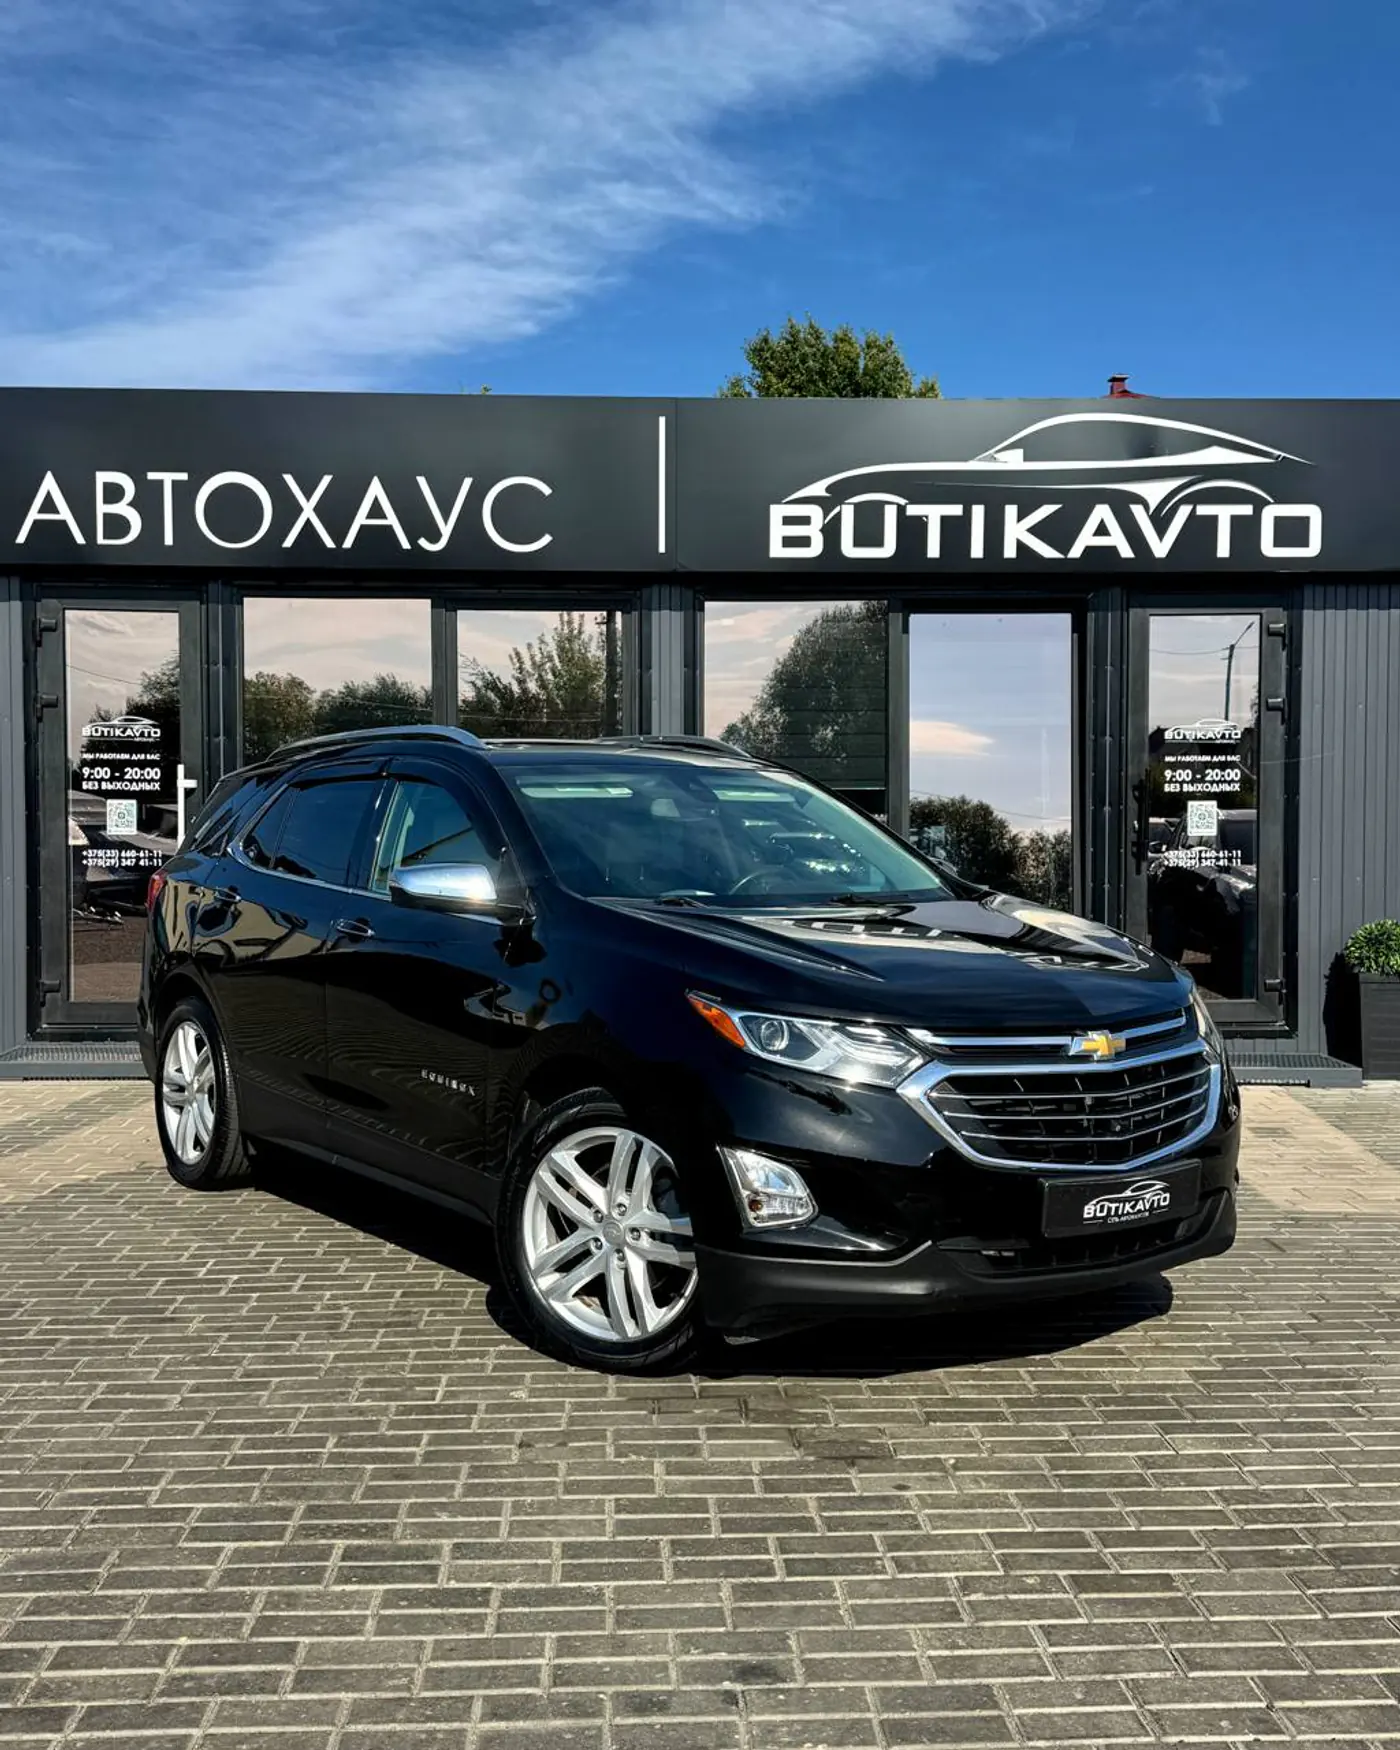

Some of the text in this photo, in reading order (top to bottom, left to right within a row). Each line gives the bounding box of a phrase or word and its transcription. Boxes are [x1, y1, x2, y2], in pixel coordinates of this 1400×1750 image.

[15, 470, 554, 553] АВТОХАУС
[768, 503, 1323, 559] BUTIKAVTO
[81, 727, 161, 737] BUTIKAVTO
[1164, 730, 1242, 740] BUTIKAVTO
[82, 767, 111, 779] 9:00
[123, 767, 161, 780] 20:00
[1164, 769, 1192, 781] 9:00
[1204, 769, 1241, 781] 20:00
[82, 781, 161, 791] БЕЗ ВЫХОДНЫХ
[1163, 783, 1241, 793] БЕЗ ВЫХОДНЫХ
[1083, 1192, 1171, 1219] BUTIKAVTO
